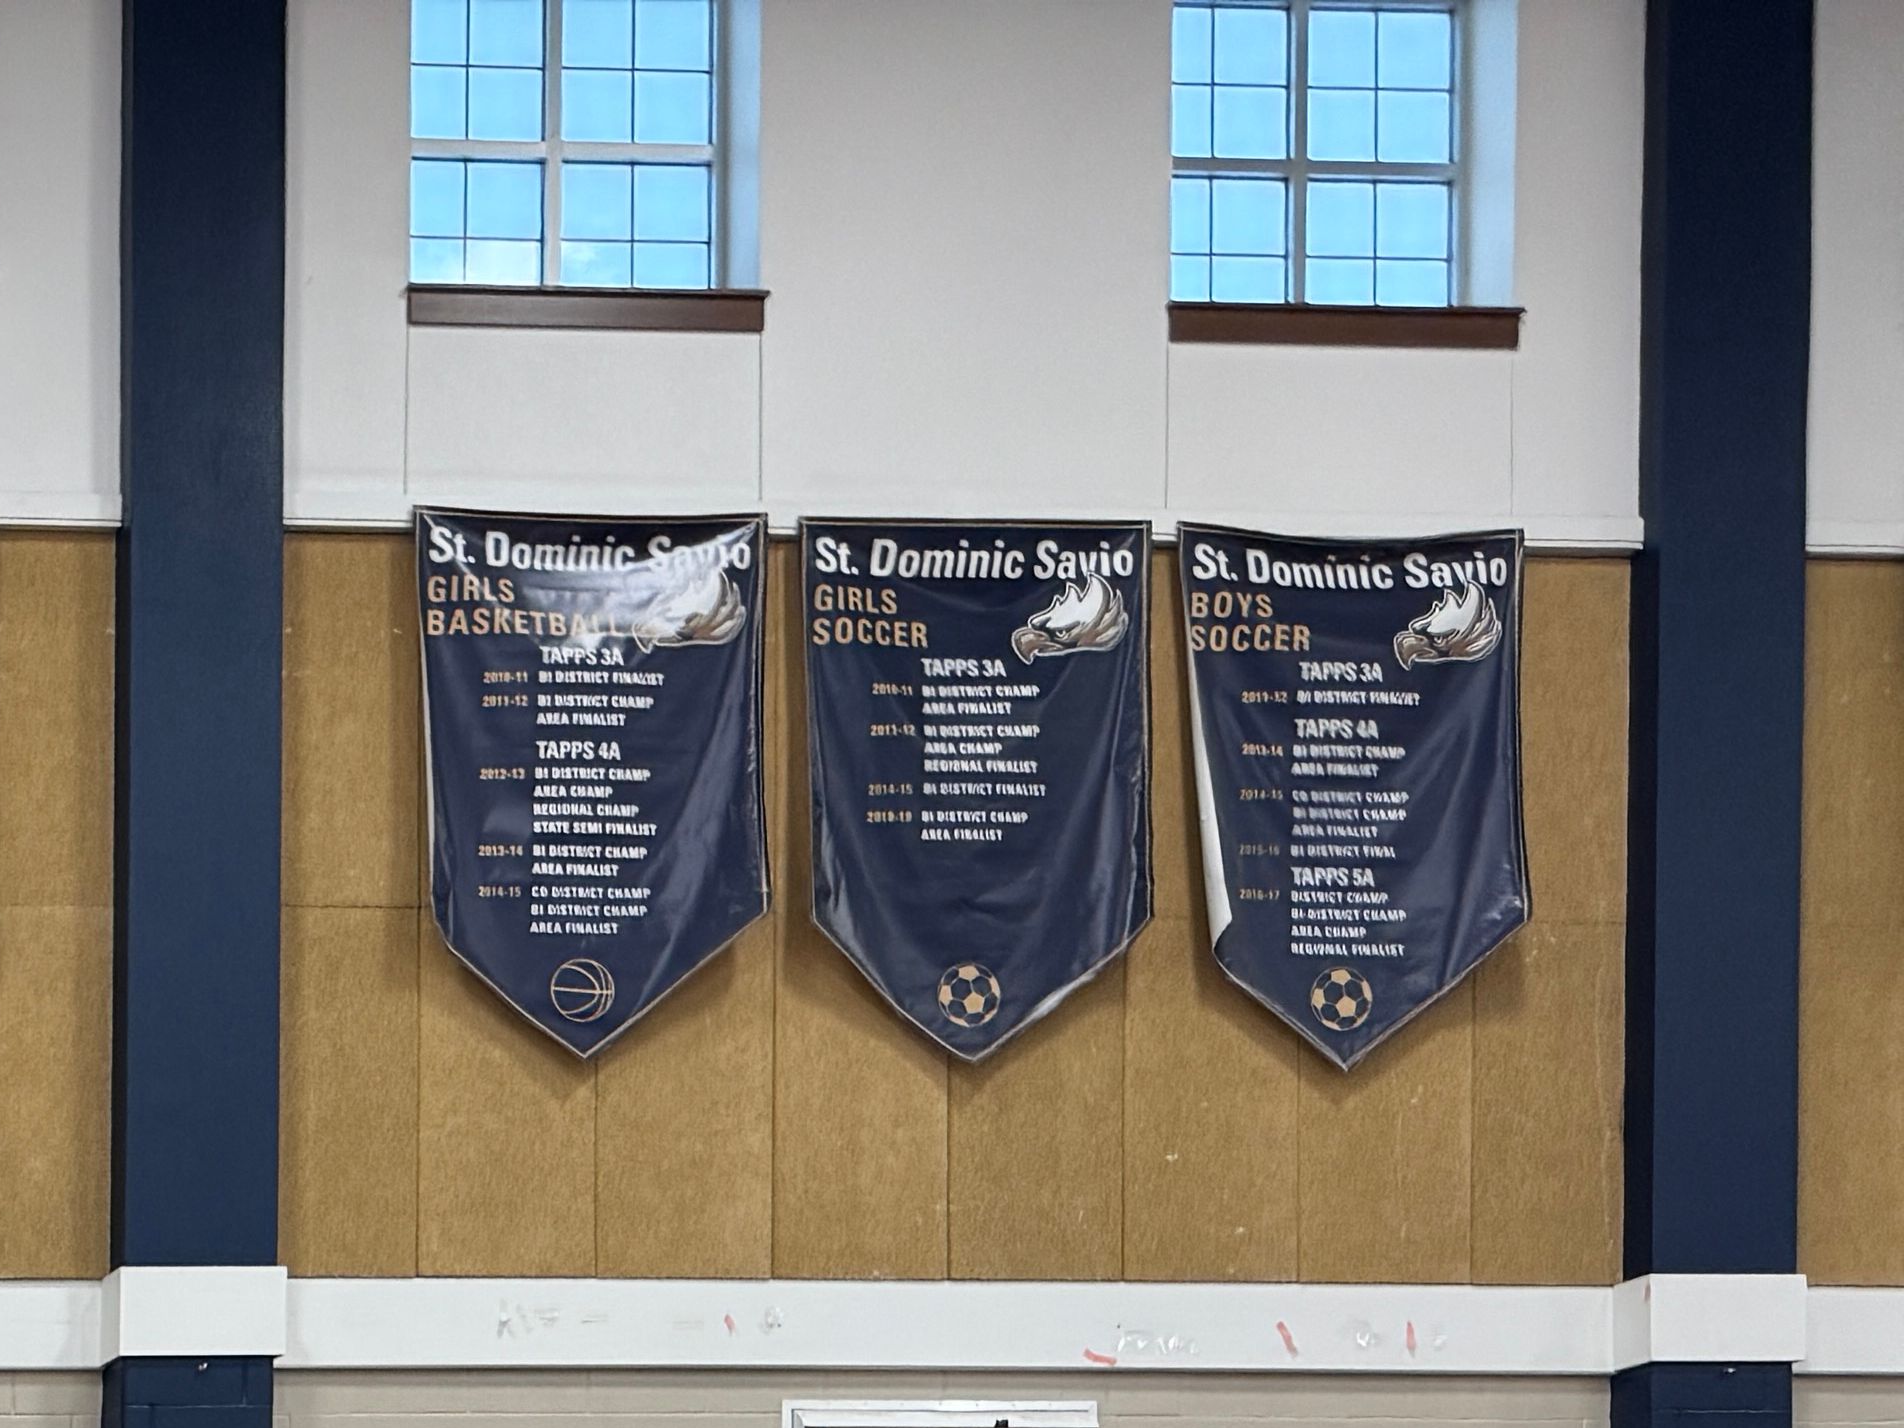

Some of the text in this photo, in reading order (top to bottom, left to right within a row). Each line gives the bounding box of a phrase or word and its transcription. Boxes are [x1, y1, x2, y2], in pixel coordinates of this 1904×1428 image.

[428, 526, 475, 564] St.
[485, 532, 635, 571] Dominic
[815, 537, 1134, 580] St. Dominic Savio
[1192, 542, 1507, 590] St. Dominic Savio
[427, 576, 515, 603] GIRLS
[815, 584, 898, 614] GIRLS
[1192, 591, 1274, 618] BOYS
[426, 608, 625, 638] BASKETBALL
[813, 617, 928, 648] SOCCER
[1191, 623, 1311, 652] SOCCER
[540, 646, 624, 666] TAPPS 3A
[921, 658, 1006, 677] TAPPS 3A
[1299, 661, 1357, 682] TAPPS
[1295, 718, 1353, 739] TAPPS
[536, 741, 621, 760] TAPPS 4A
[533, 821, 570, 833] STATE
[1291, 867, 1375, 887] TAPPS 5A
